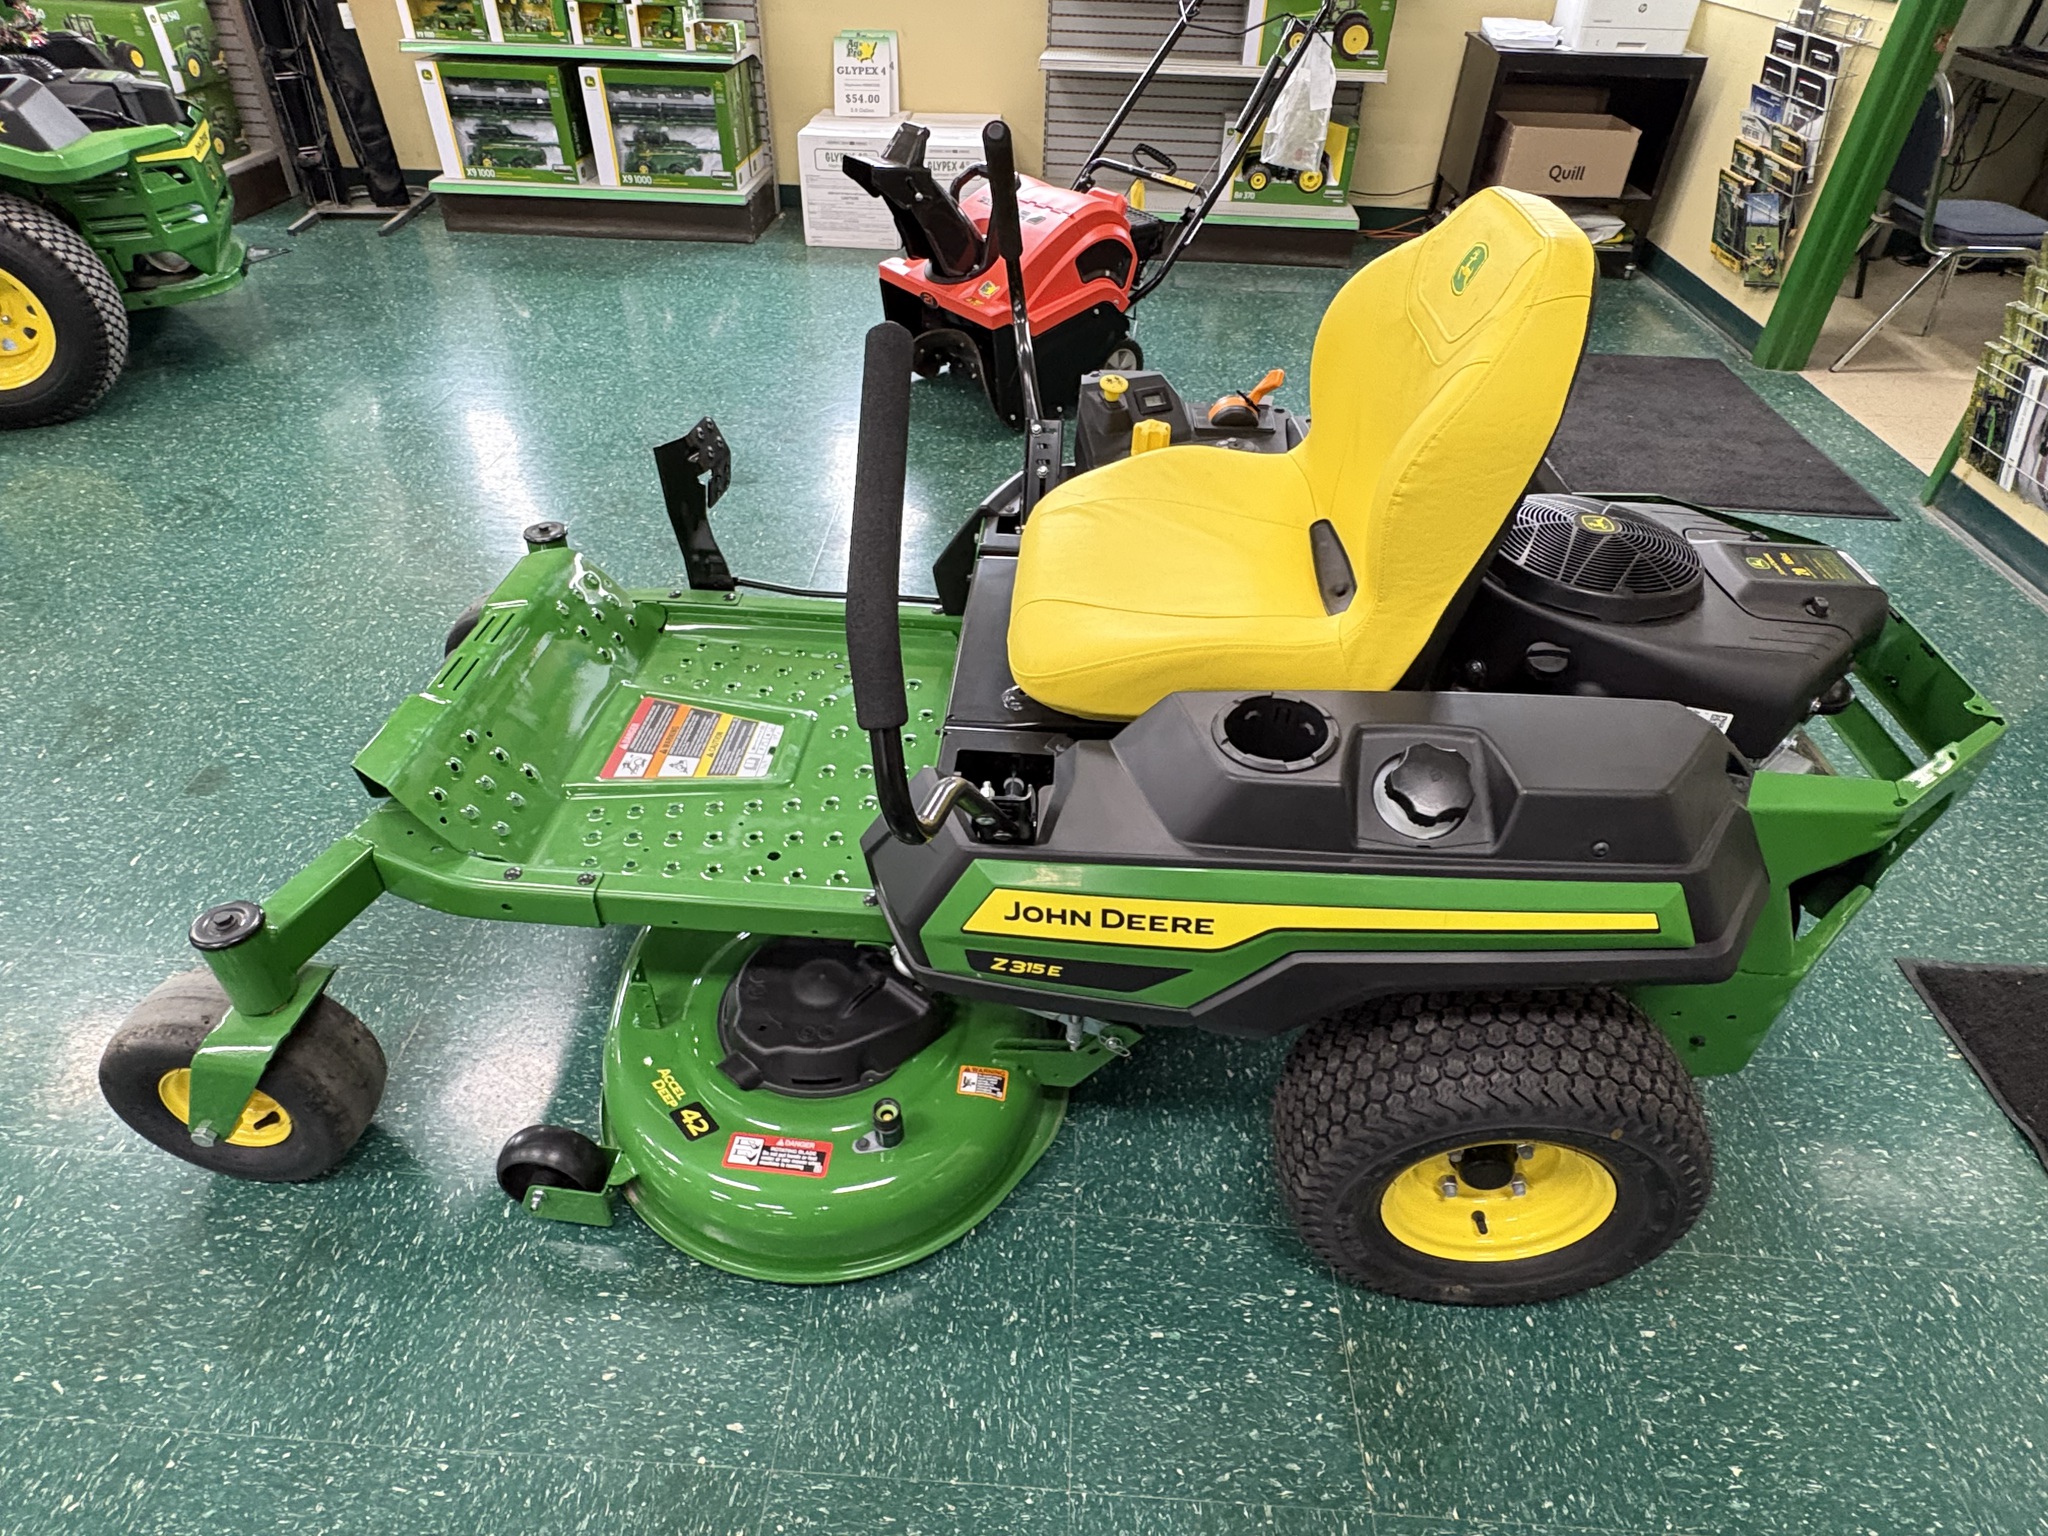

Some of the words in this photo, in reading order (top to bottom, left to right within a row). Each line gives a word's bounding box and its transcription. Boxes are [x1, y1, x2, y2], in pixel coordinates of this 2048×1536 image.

[846, 48, 863, 57] Pro
[836, 66, 879, 75] GLYPEX
[880, 66, 887, 76] 4
[845, 93, 880, 104] $54.00
[465, 167, 477, 177] X9
[477, 168, 496, 178] 1000
[927, 160, 957, 172] GLYPEX
[622, 174, 633, 183] X9
[634, 175, 652, 185] 1000
[1549, 165, 1586, 182] Quill
[662, 725, 680, 749] WARNING
[708, 731, 724, 752] CAUTION
[1004, 901, 1091, 927] JOHN
[1101, 908, 1215, 935] DEERE
[656, 1068, 687, 1101] ACCEL
[651, 1078, 679, 1108] DEEP
[679, 1109, 710, 1137] 42
[784, 1139, 816, 1149] DANGER
